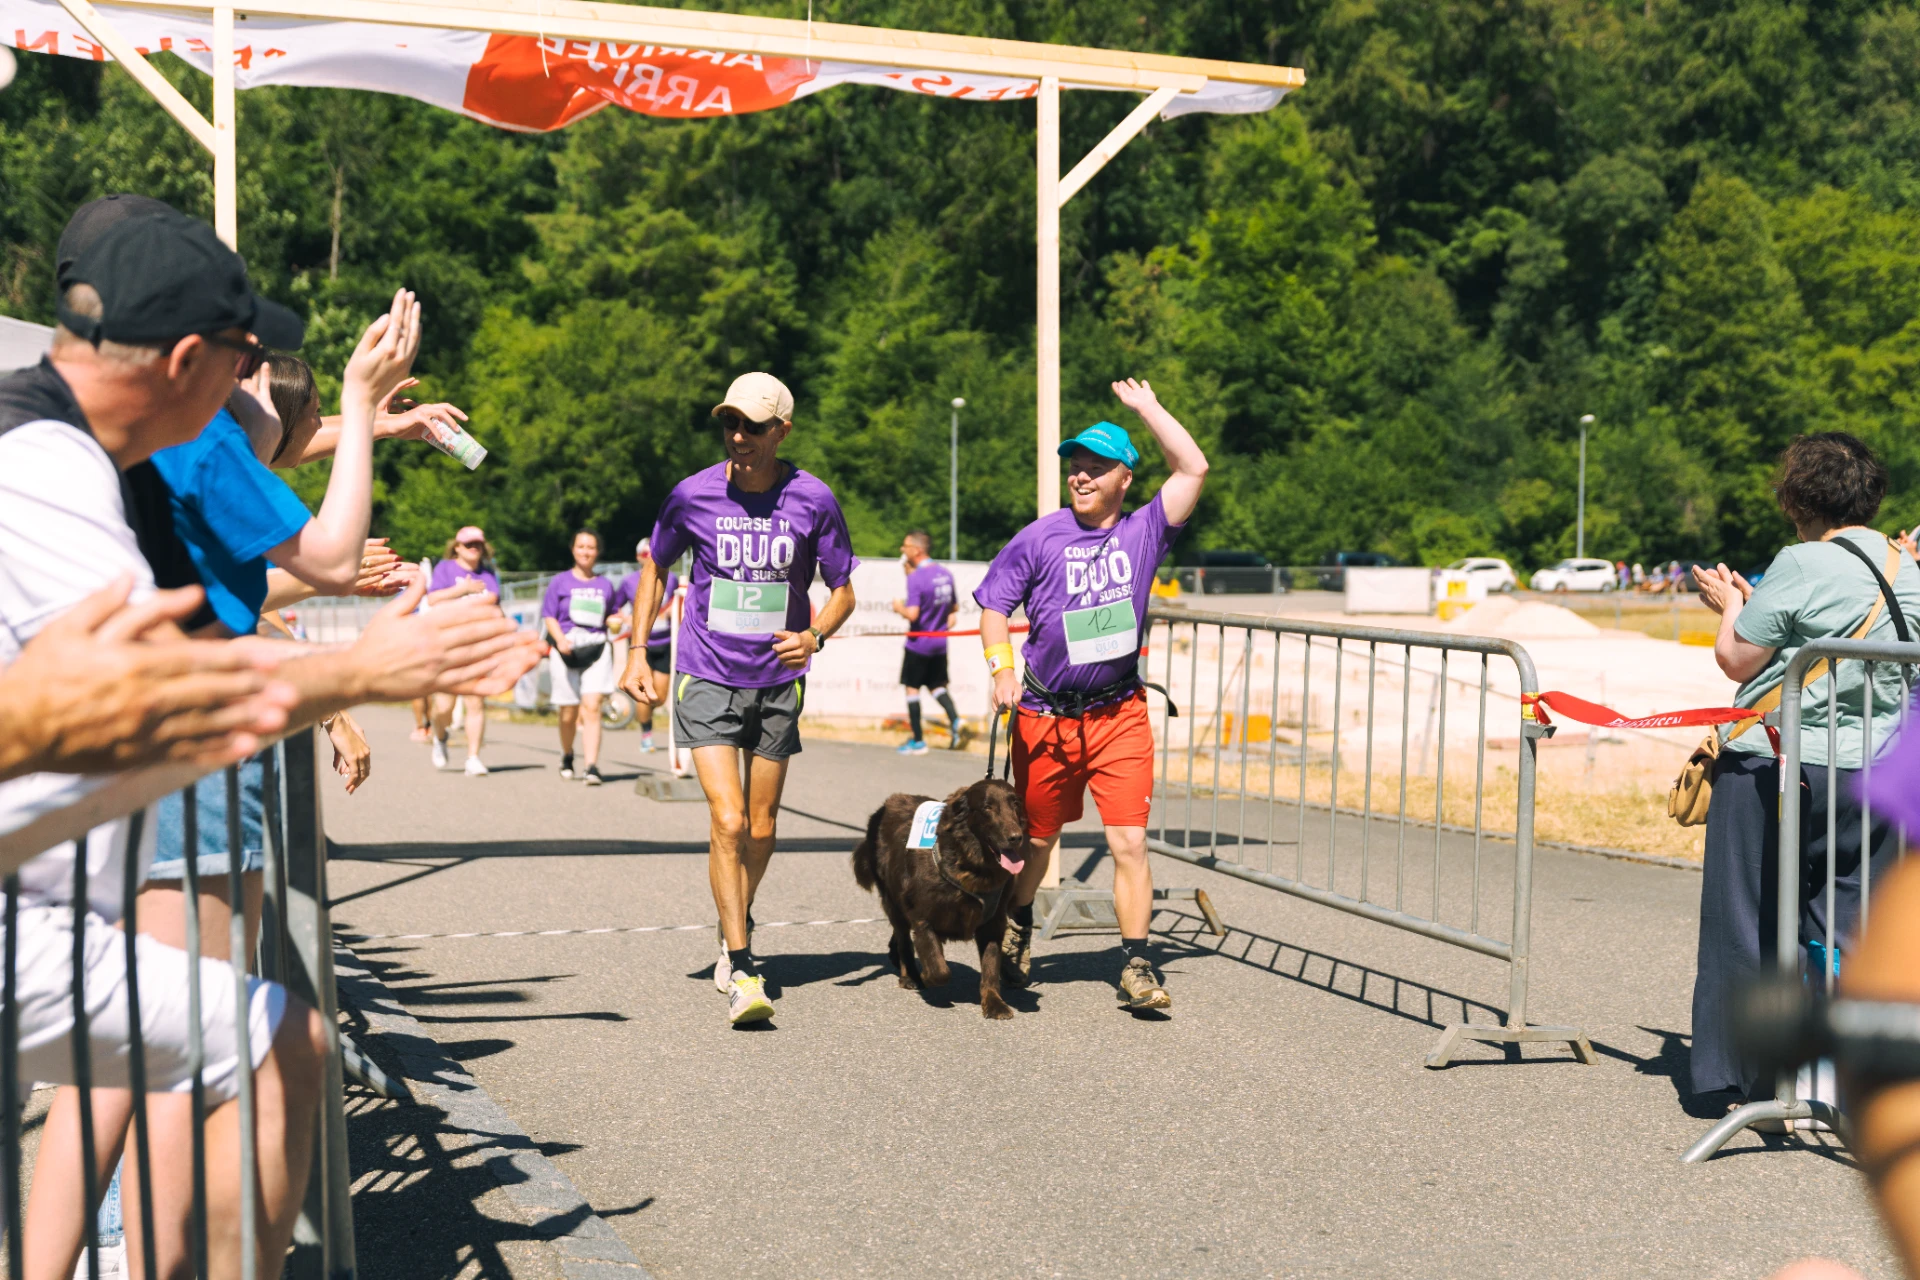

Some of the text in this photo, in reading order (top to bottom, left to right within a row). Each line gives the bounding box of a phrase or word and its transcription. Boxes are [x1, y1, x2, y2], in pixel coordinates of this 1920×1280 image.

[716, 516, 772, 532] COURSE
[716, 533, 795, 570] DUO
[1066, 550, 1132, 595] DUO
[737, 586, 762, 610] 12
[1088, 607, 1117, 633] 12
